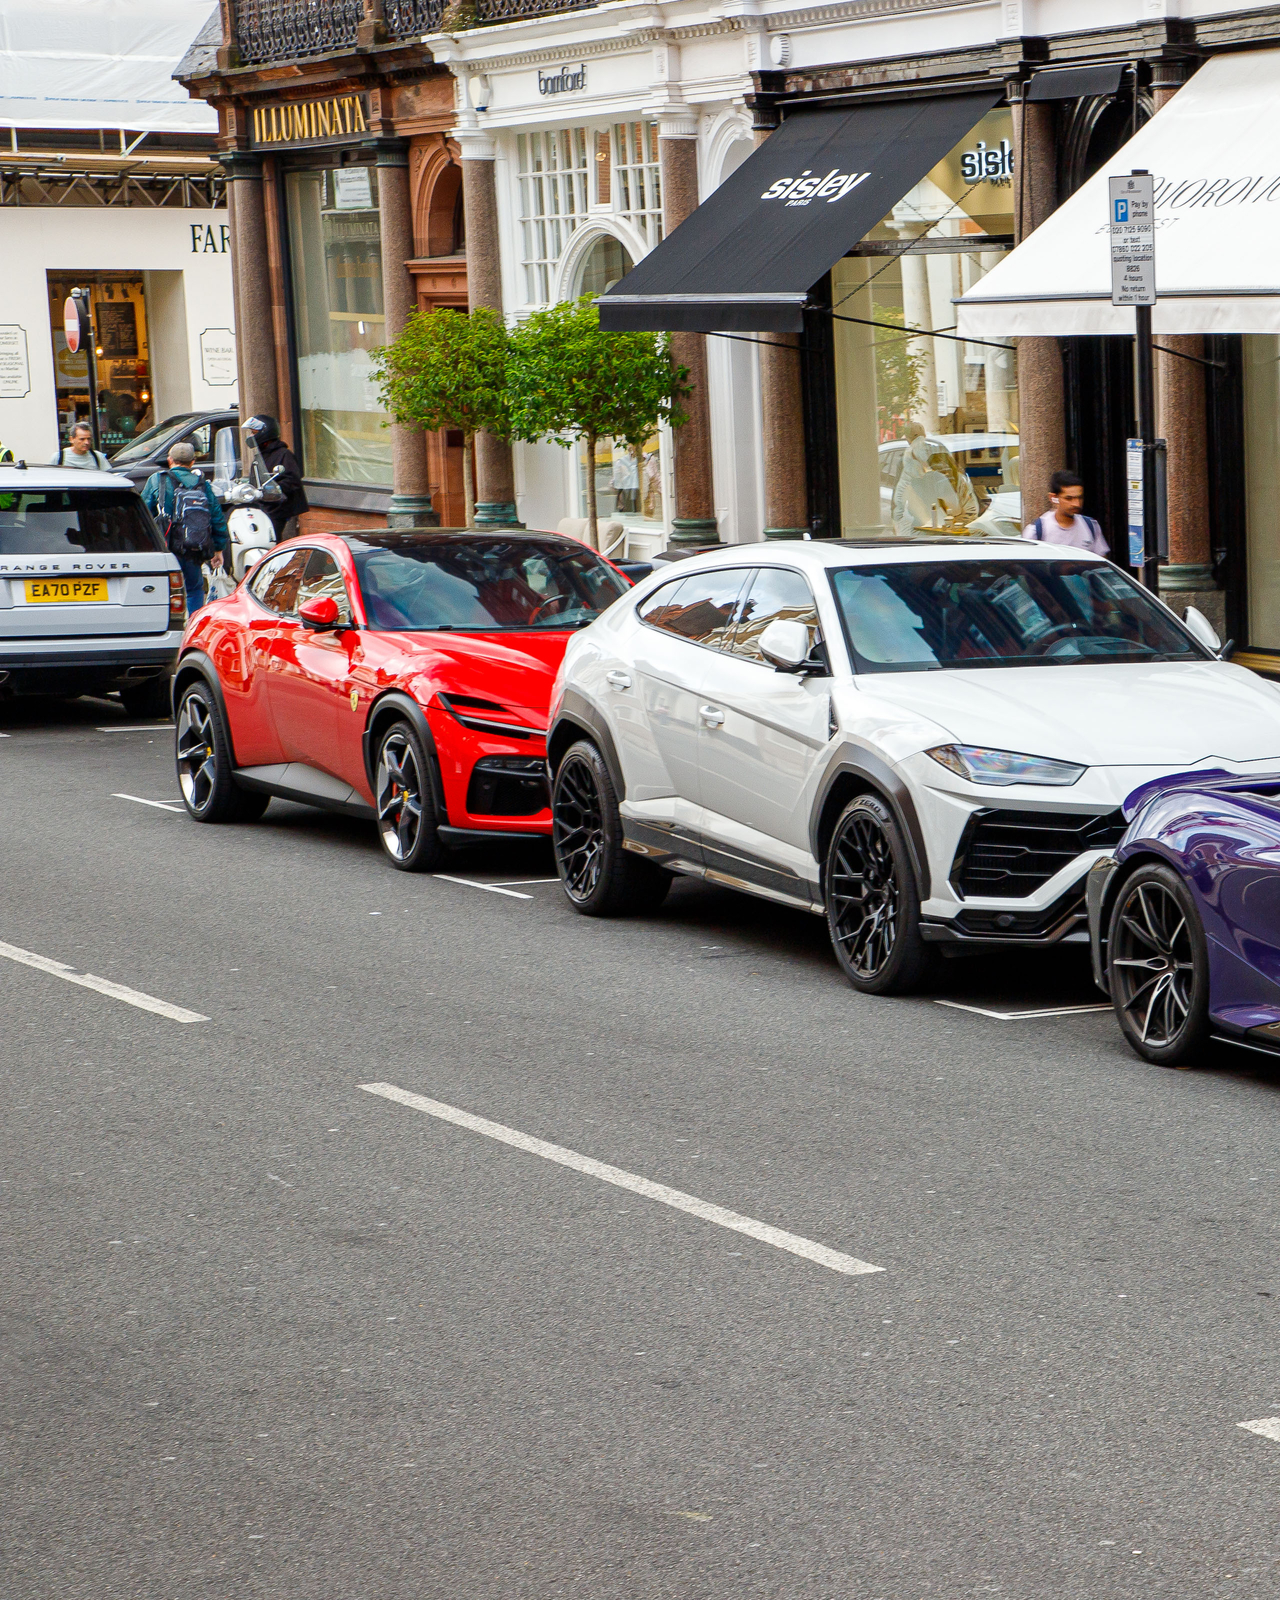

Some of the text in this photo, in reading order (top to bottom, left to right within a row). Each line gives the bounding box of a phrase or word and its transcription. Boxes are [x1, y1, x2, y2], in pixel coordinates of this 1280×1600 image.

[253, 94, 367, 143] ILLUMINATA
[760, 168, 872, 204] sisley
[785, 199, 812, 207] PARIS
[1131, 200, 1149, 209] Pay by
[1132, 210, 1148, 218] phone
[1113, 255, 1132, 263] quoting
[32, 582, 101, 597] EA70 PZF
